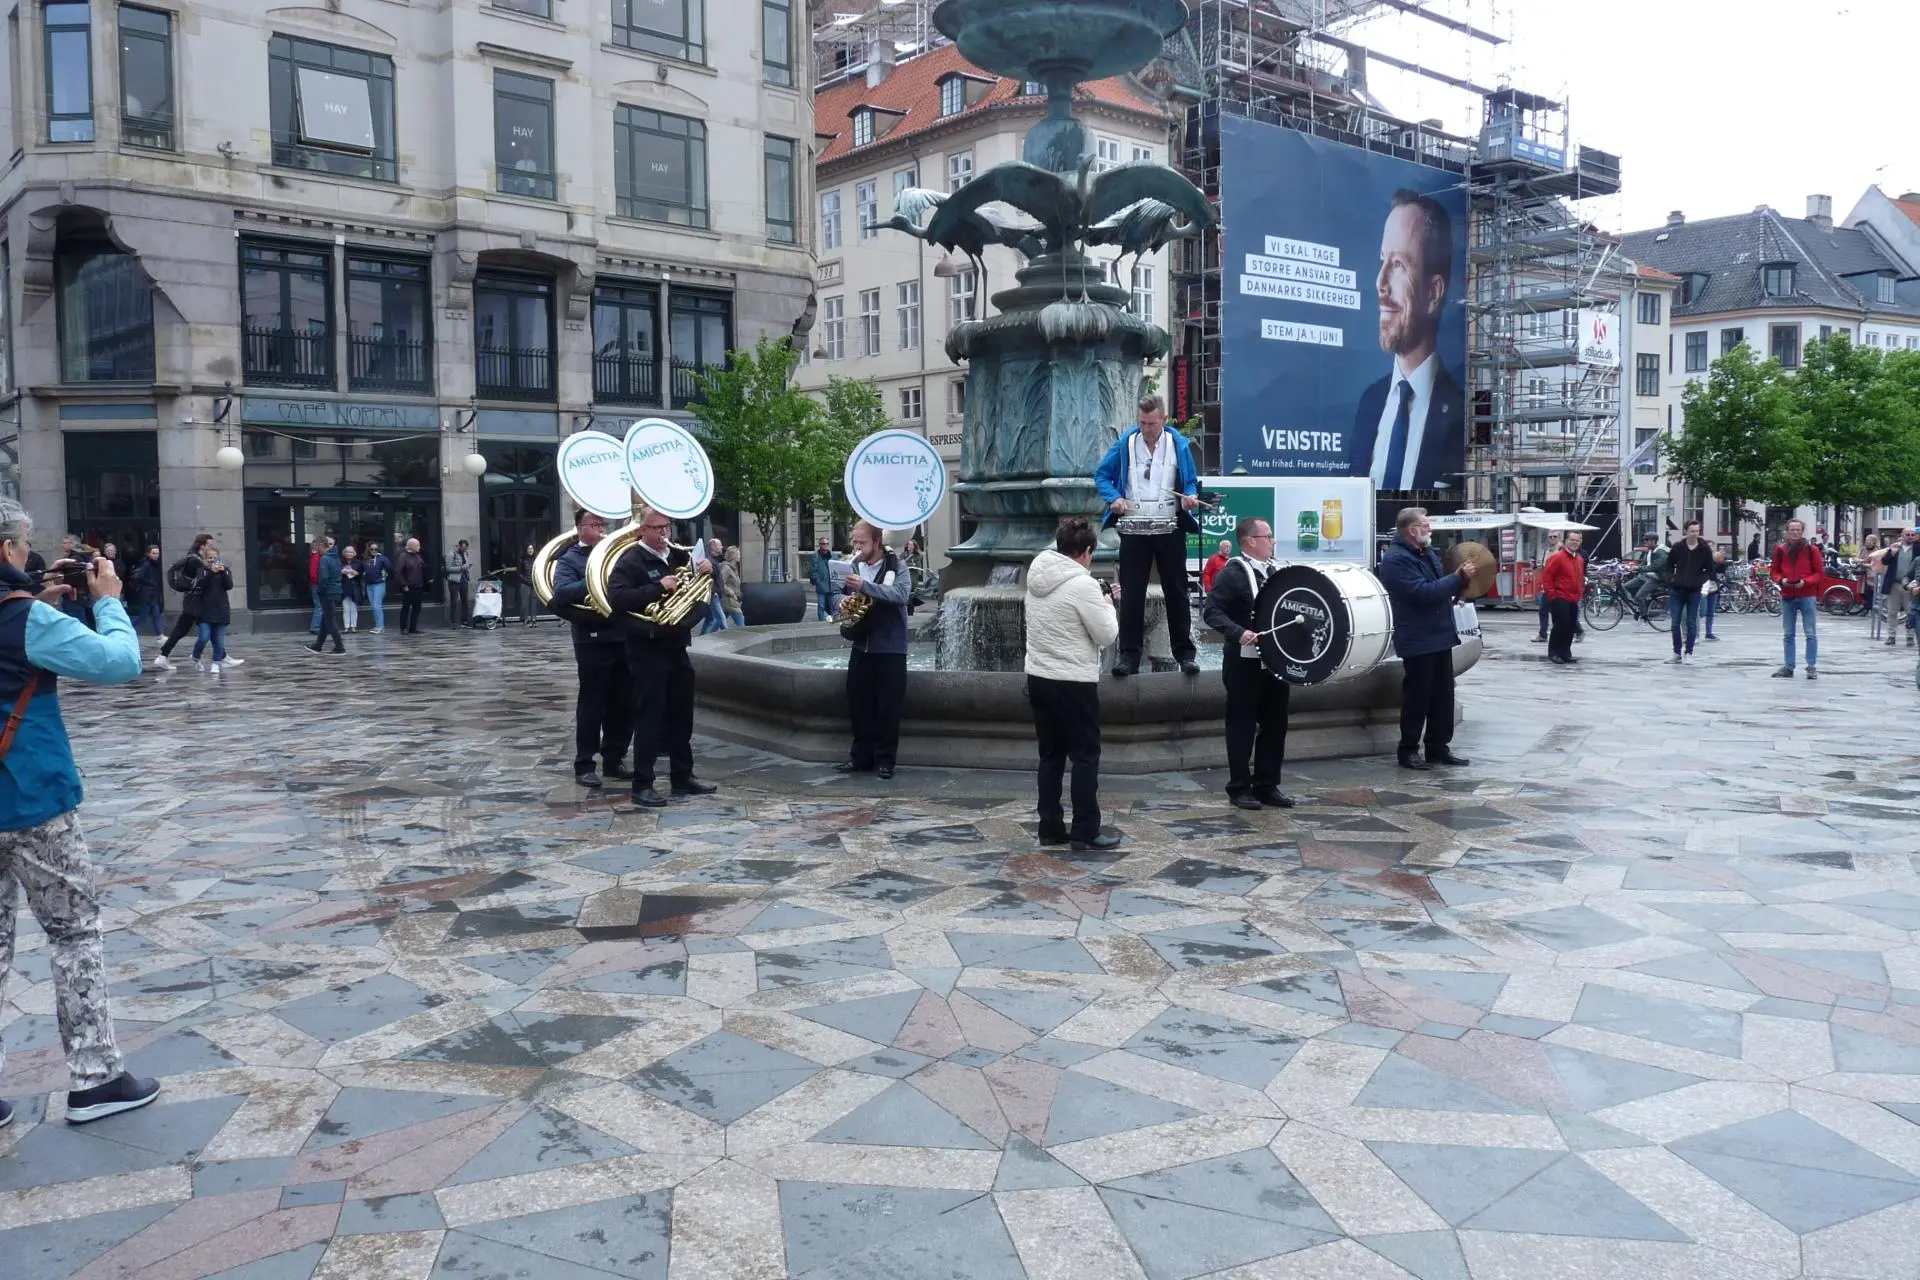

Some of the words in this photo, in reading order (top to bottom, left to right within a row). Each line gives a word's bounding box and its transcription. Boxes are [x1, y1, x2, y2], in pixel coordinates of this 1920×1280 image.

[324, 102, 348, 115] HAY
[512, 125, 534, 138] HAY
[651, 161, 669, 174] HAY
[1271, 241, 1280, 253] VI
[1284, 243, 1309, 257] SKAL
[1312, 248, 1335, 262] TAGE
[1252, 260, 1291, 275] STØRRE
[1295, 266, 1330, 281] ANSVAR
[1333, 272, 1351, 285] FOR
[1247, 280, 1302, 298] DANMARKS
[1306, 288, 1355, 306] SIKKERHED
[1267, 324, 1293, 337] STEM
[1296, 328, 1307, 341] JA
[1319, 331, 1338, 344] JUNI
[1176, 366, 1188, 424] FRIDAYS
[335, 405, 407, 428] NORDEN
[1261, 424, 1342, 452] VENSTRE
[568, 451, 621, 469] AMICITIA
[632, 439, 684, 463] AMICITIA
[862, 455, 929, 465] AMICITIA
[1251, 459, 1270, 468] Mere
[1272, 459, 1295, 468] frihed.
[1297, 459, 1315, 468] Flere
[1280, 600, 1325, 618] AMICITIA
